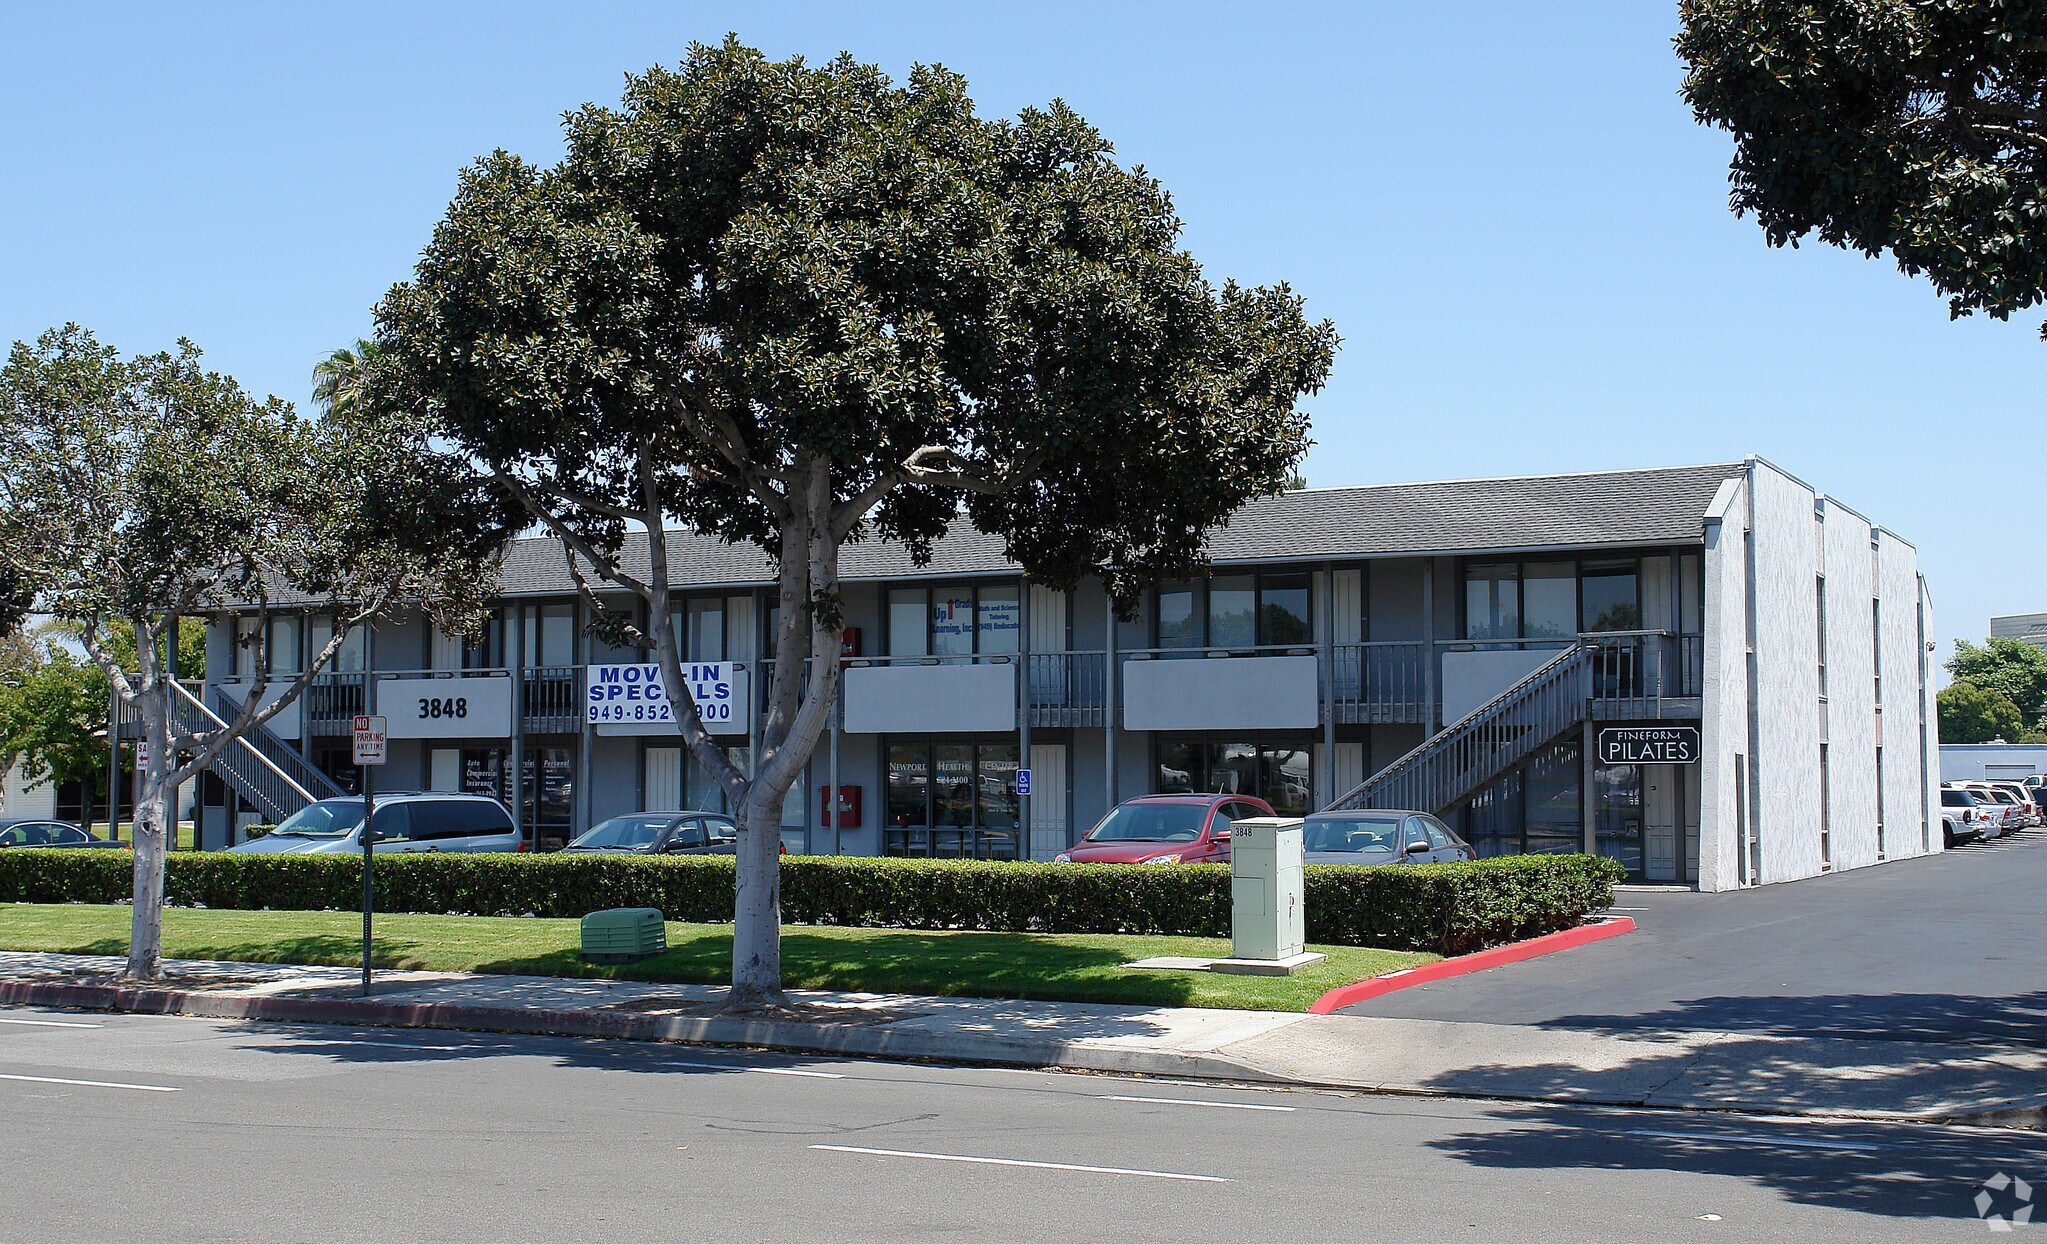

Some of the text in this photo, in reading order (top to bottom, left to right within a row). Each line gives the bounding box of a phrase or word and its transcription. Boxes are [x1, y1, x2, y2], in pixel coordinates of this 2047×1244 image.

[600, 665, 720, 683] MOV-IN
[589, 683, 730, 701] SPECLS
[418, 697, 468, 719] 3848
[356, 718, 368, 729] NO
[356, 732, 384, 742] PARKING
[1617, 731, 1681, 741] FINEFORM
[370, 743, 384, 751] TIME
[1609, 741, 1689, 760] PILATES
[1236, 828, 1252, 836] 3848
